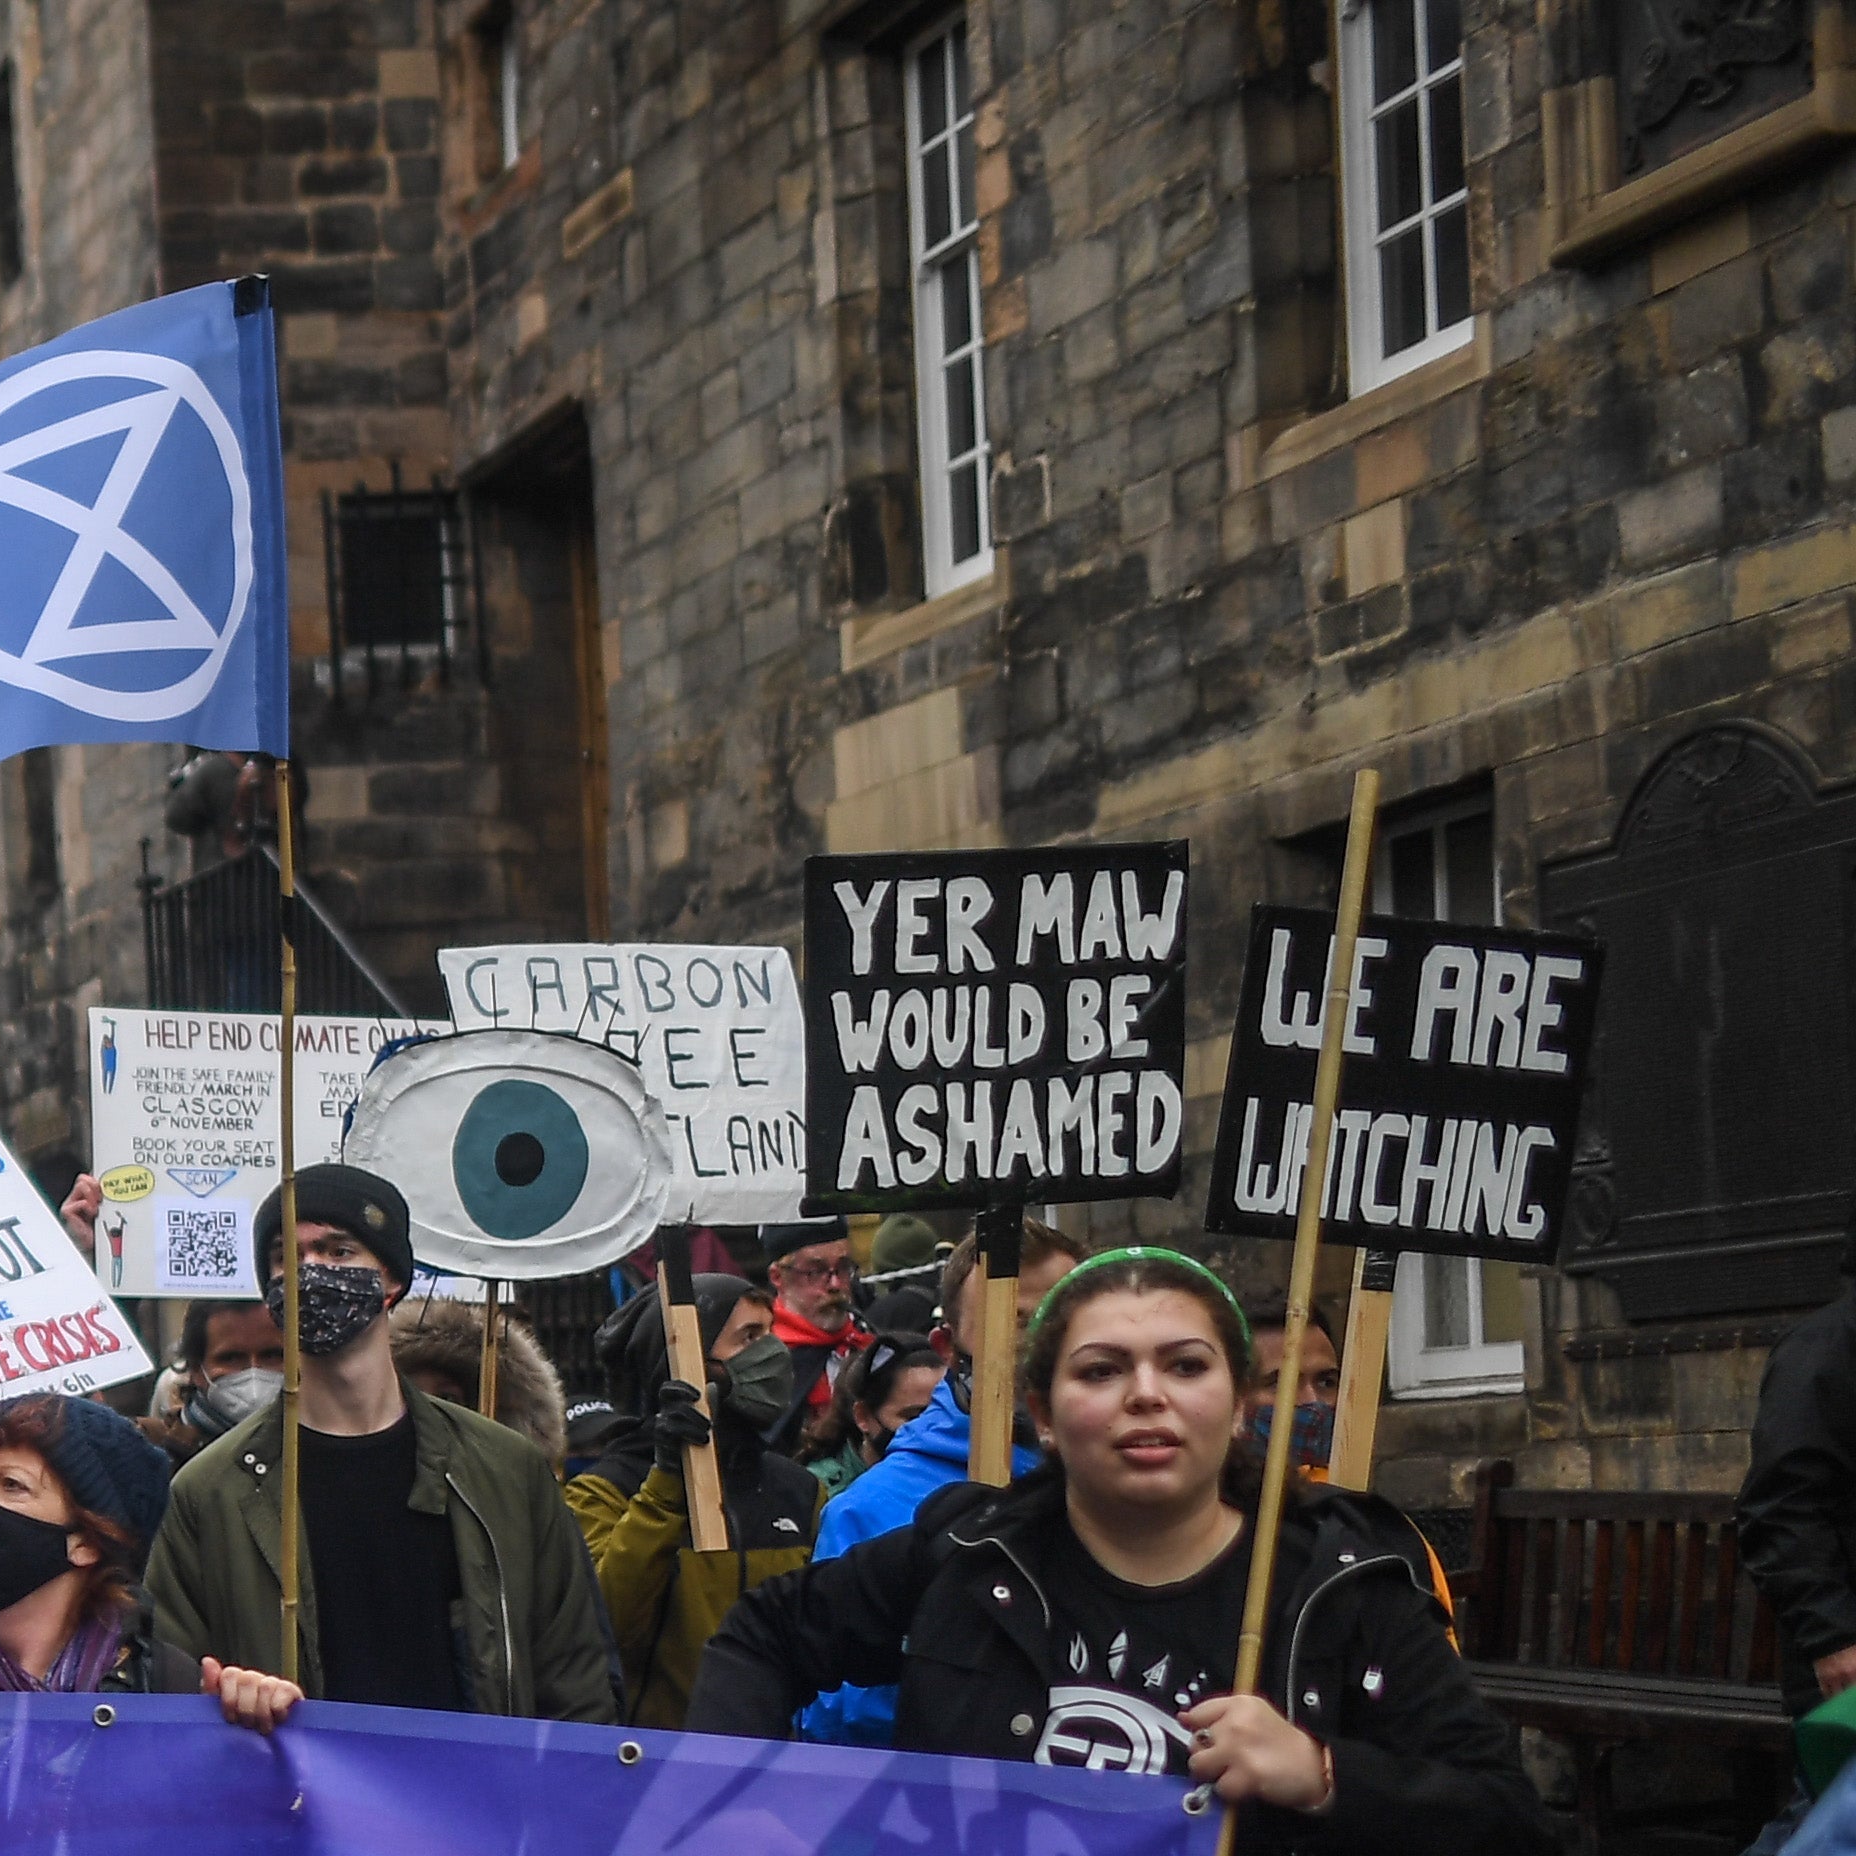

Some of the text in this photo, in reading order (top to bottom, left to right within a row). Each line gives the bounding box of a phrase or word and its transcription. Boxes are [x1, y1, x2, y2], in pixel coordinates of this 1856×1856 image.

[833, 868, 1185, 977] YER MAW
[464, 952, 775, 1023] CARBON
[1259, 927, 1585, 1075] WE ARE
[144, 1018, 202, 1050] HELP
[208, 1020, 253, 1052] END
[259, 1022, 362, 1055] CLMATE
[830, 973, 1154, 1075] WOULD BE
[605, 1026, 771, 1090] REE
[131, 1066, 159, 1080] JOIN
[163, 1066, 186, 1080] THE
[319, 1071, 357, 1086] TAKE
[136, 1080, 271, 1097] FRIENDLY MARCH IN
[142, 1095, 264, 1116] GLASGOW
[169, 1116, 255, 1131] NOVEMBER
[835, 1068, 1184, 1192] ASHAMED
[132, 1136, 275, 1155] BOOK YOUR SEAT
[134, 1151, 276, 1168] ON OUR COACHES
[184, 1172, 219, 1186] SCAN
[1233, 1094, 1557, 1243] WATCHING
[12, 1303, 123, 1372] CRISIS
[566, 1401, 614, 1421] POLICE
